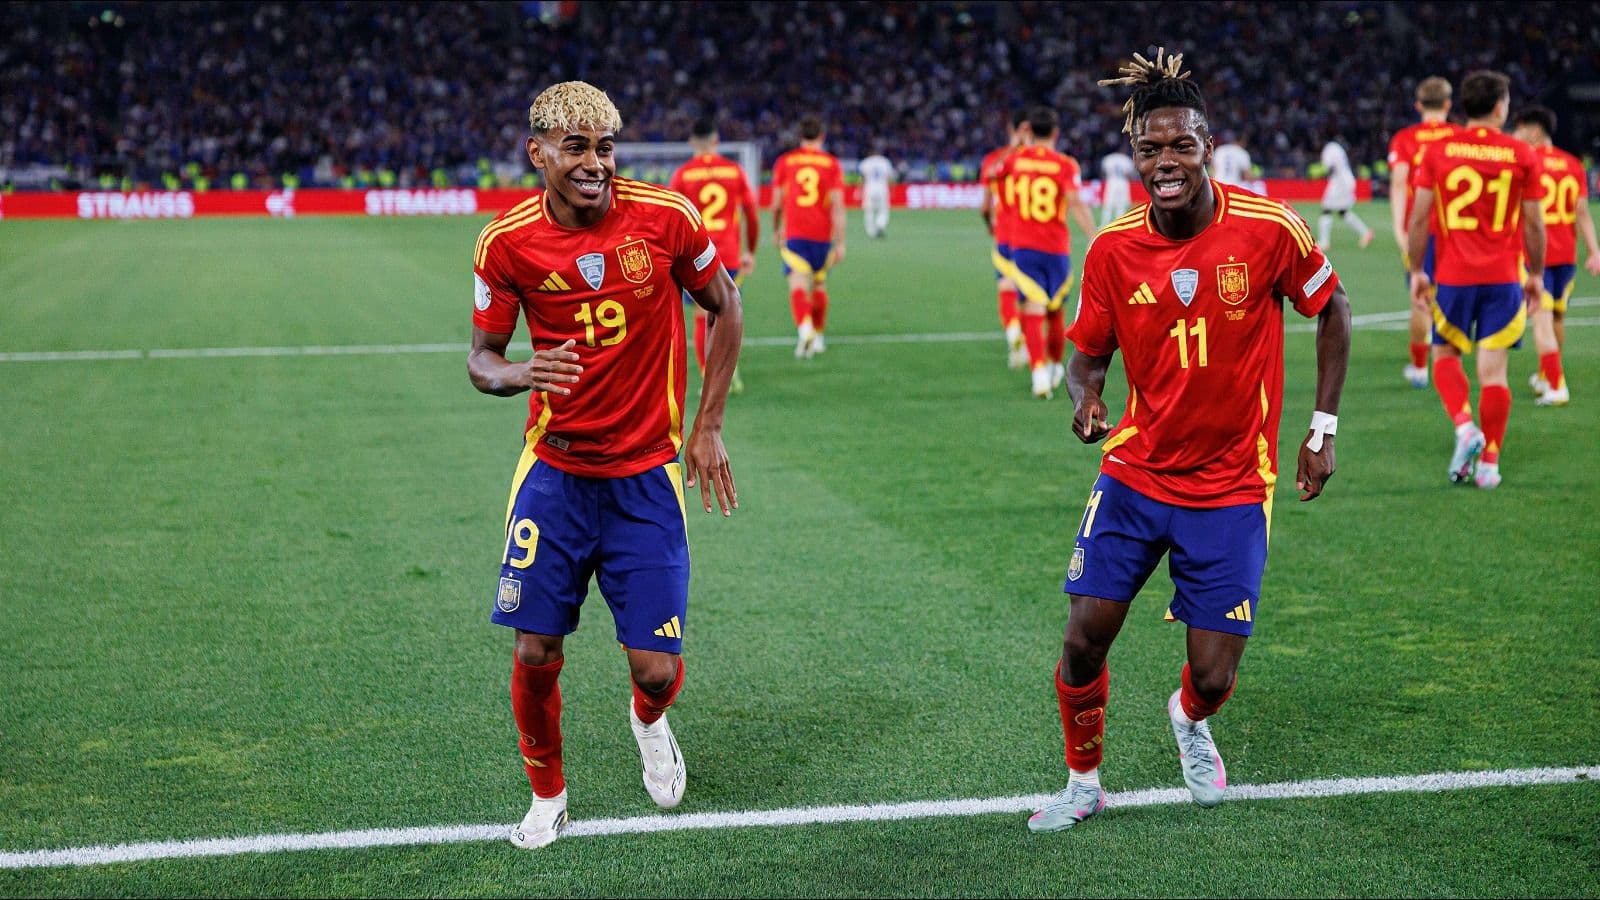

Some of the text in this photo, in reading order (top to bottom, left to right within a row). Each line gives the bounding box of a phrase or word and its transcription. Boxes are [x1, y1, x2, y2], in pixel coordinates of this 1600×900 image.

[77, 192, 194, 218] STRAUSS
[365, 189, 477, 215] STRAUSS
[699, 183, 728, 231] 2
[795, 166, 820, 207] 3
[1014, 174, 1059, 223] 18
[1446, 165, 1513, 232] 21
[1539, 173, 1580, 224] 20
[574, 299, 627, 347] 19
[1170, 316, 1208, 369] 11
